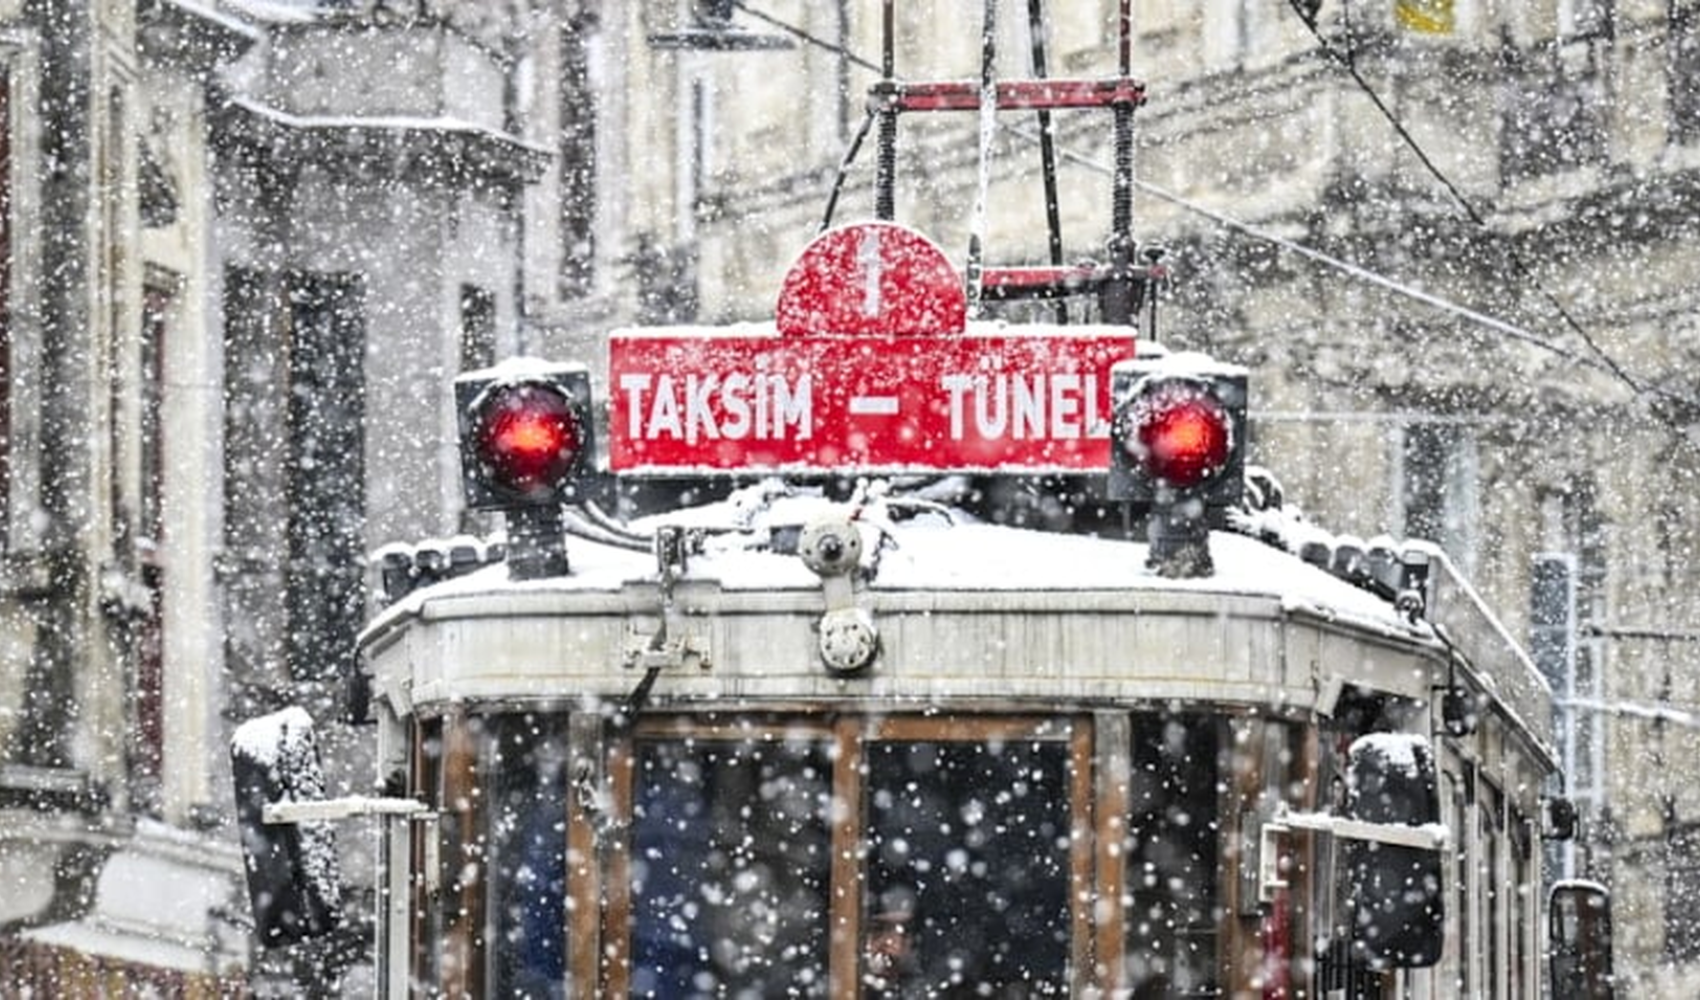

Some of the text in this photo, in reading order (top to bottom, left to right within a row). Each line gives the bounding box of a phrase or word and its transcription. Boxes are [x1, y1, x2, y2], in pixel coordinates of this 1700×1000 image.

[857, 228, 880, 318] 1
[620, 354, 813, 440] TAKSİM
[941, 354, 1112, 440] TÜNEL
